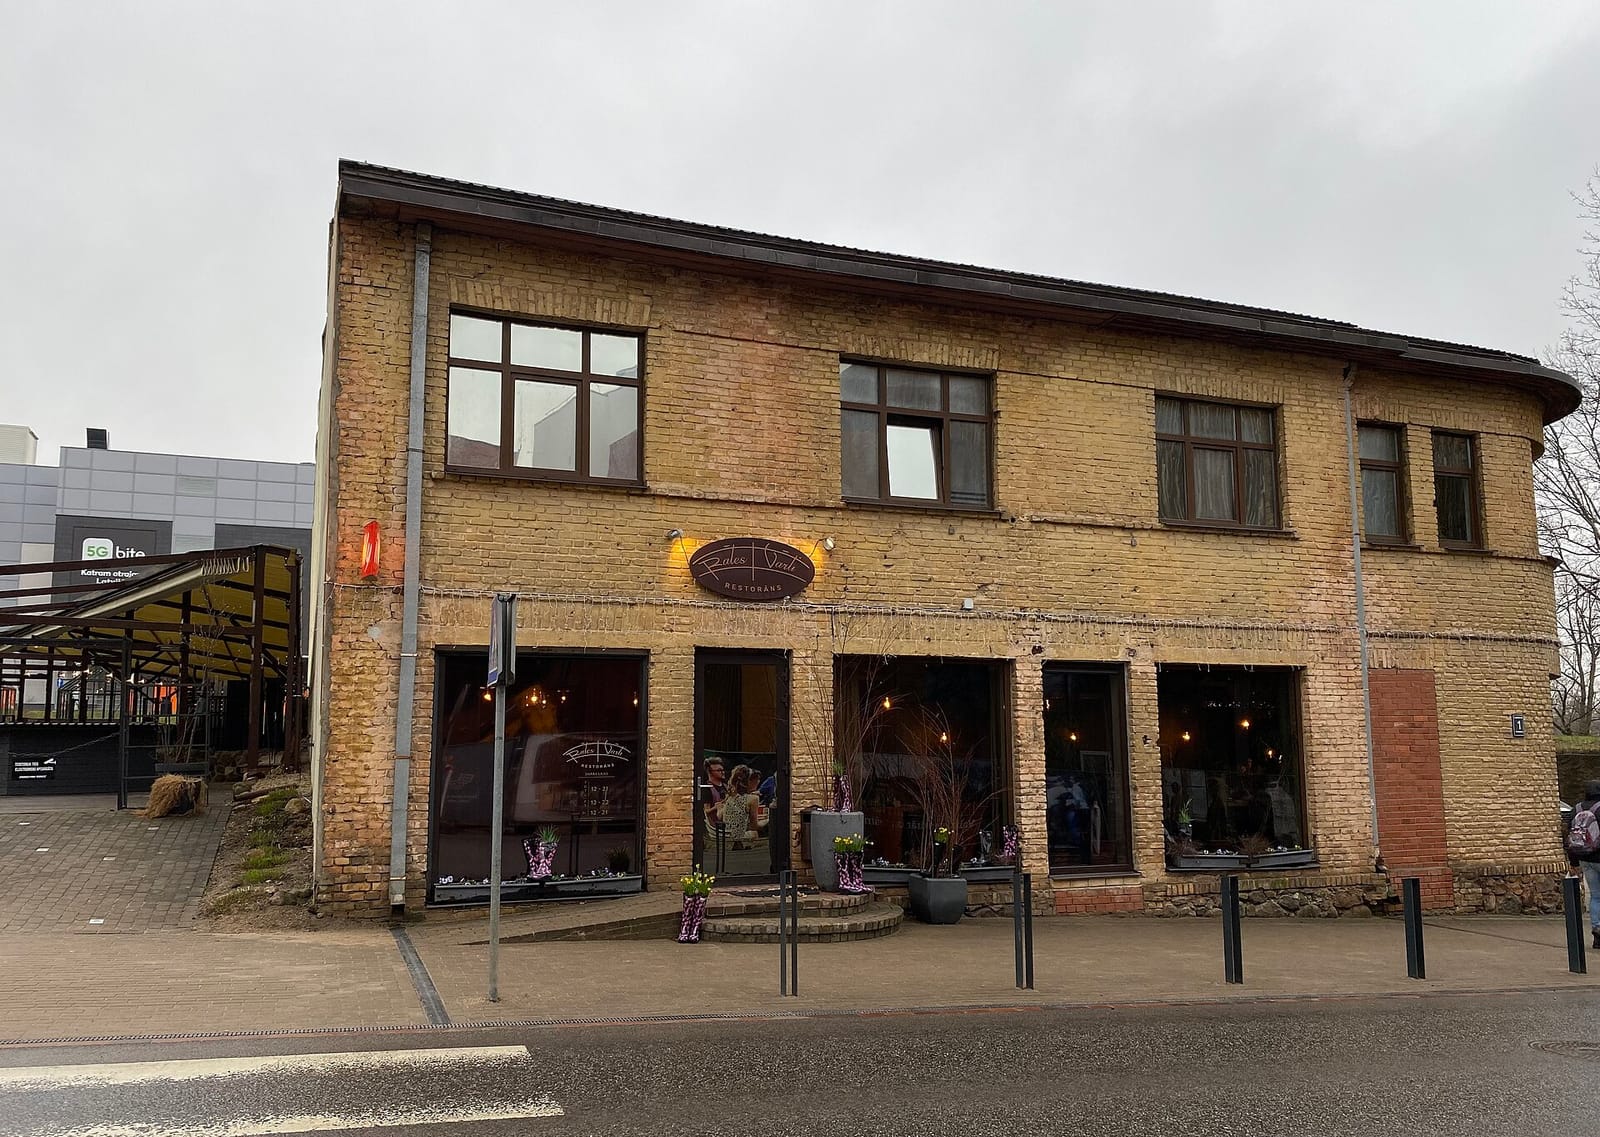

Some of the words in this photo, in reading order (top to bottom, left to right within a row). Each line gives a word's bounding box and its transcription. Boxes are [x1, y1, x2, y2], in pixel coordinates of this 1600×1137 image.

[87, 545, 109, 557] 5G
[115, 545, 146, 559] bite
[80, 569, 111, 577] Katram
[724, 582, 782, 593] RESTORĀNS
